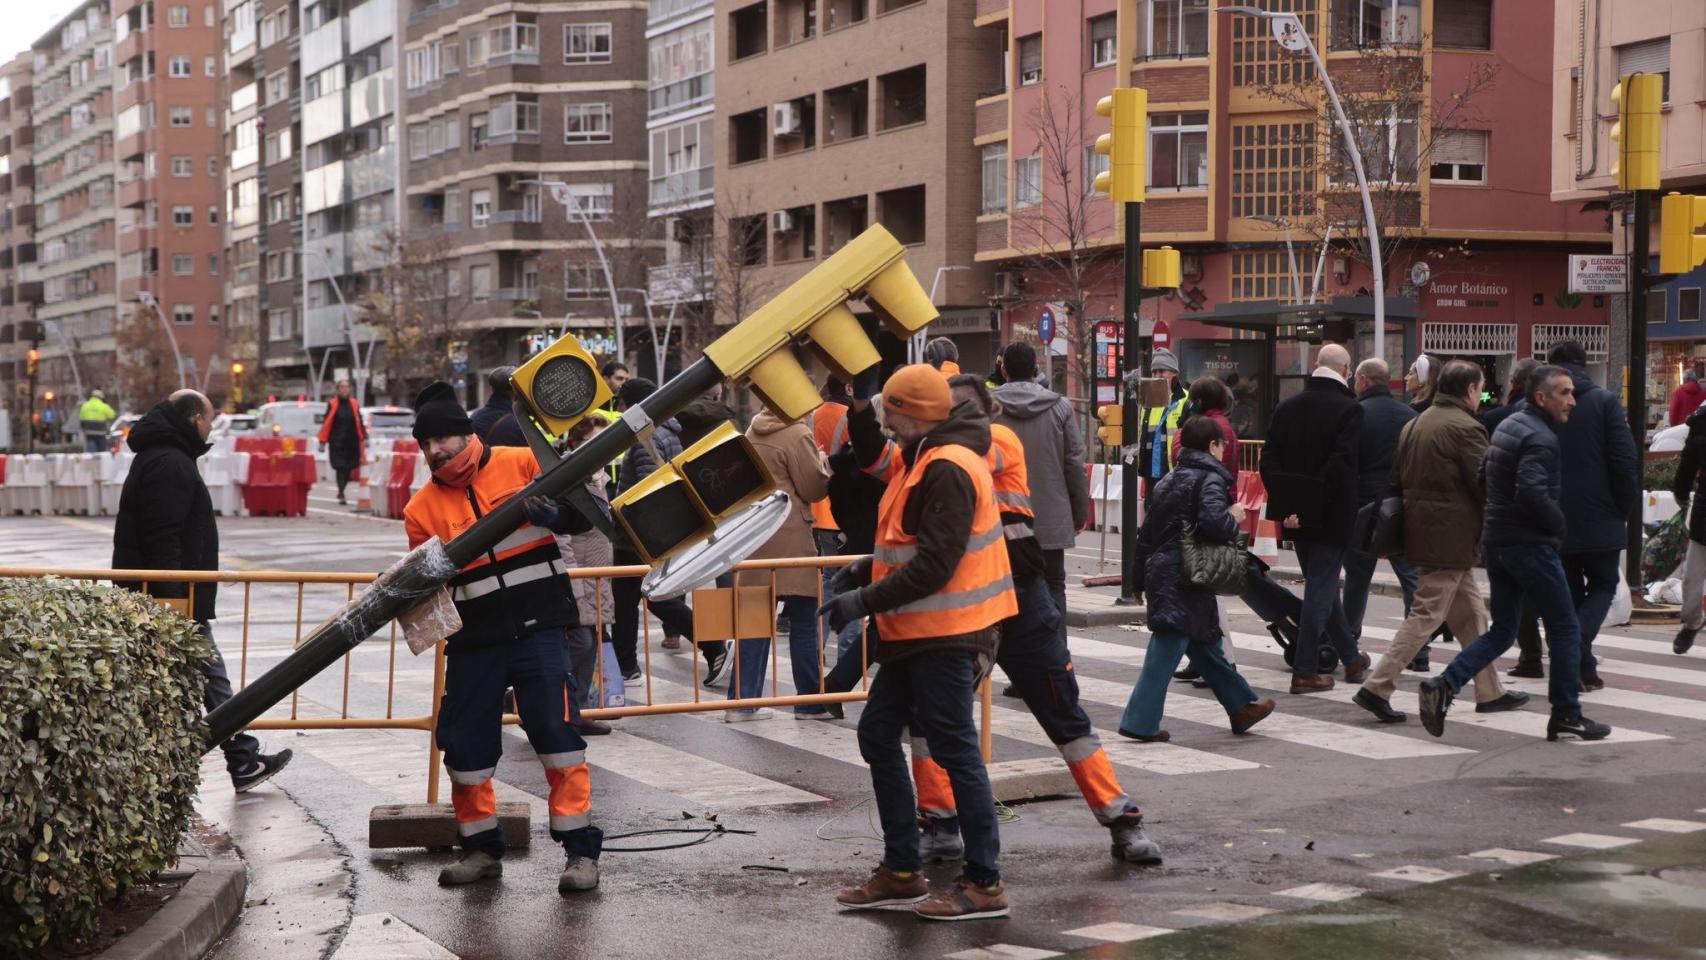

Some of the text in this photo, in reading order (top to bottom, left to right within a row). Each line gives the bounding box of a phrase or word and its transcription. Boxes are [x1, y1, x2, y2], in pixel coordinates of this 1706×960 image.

[1429, 281, 1508, 296] Amor Botánico
[1453, 299, 1466, 307] GIRL
[1099, 326, 1113, 334] BUS
[1205, 361, 1239, 369] TISSOT
[1096, 367, 1107, 378] 52
